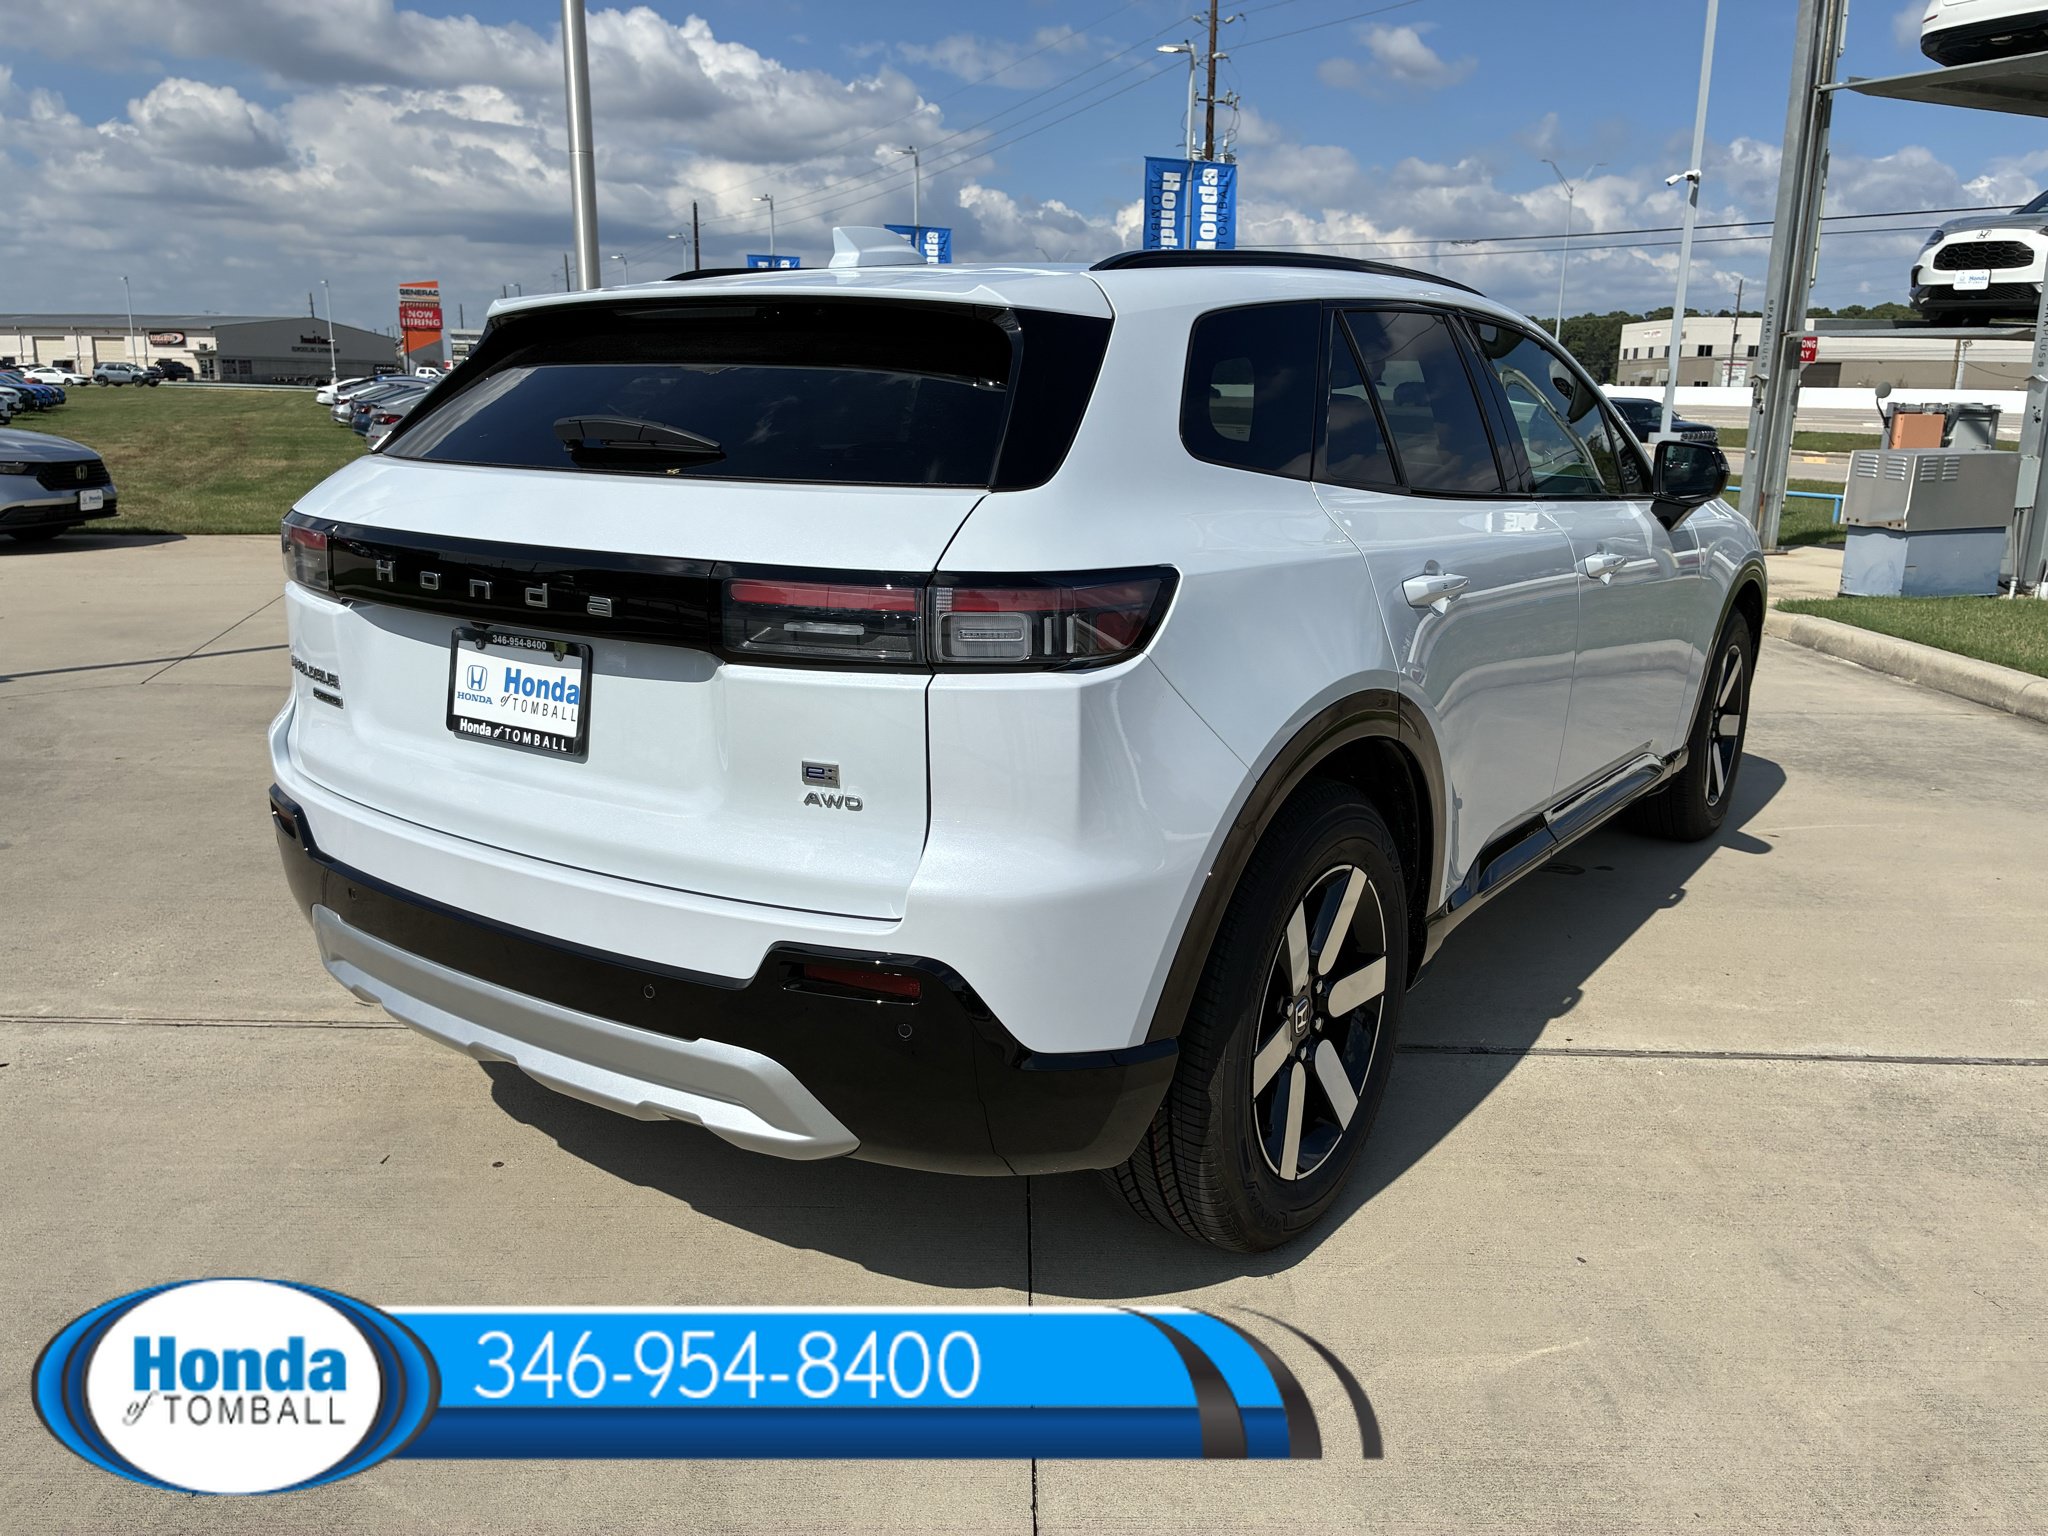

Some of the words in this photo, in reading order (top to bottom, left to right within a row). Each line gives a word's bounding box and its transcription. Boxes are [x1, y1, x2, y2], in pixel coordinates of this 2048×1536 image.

[1151, 184, 1161, 249] TOMBAL
[1160, 171, 1181, 249] Hond
[1218, 171, 1229, 248] TOMBALL
[924, 231, 939, 265] nda
[399, 288, 439, 296] GENERAC
[402, 318, 440, 327] HIRING
[407, 310, 433, 318] NOW
[1800, 350, 1811, 358] AY
[1801, 340, 1816, 348] ONG
[376, 559, 613, 618] Honda
[492, 634, 547, 650] 346-954-8400
[503, 666, 580, 705] Honda
[457, 691, 493, 705] HONDA
[500, 694, 513, 707] of
[512, 697, 576, 722] TOMBALL
[459, 718, 492, 737] Honda
[493, 726, 504, 738] of
[504, 728, 567, 751] TOMBALL
[803, 791, 863, 812] AWD
